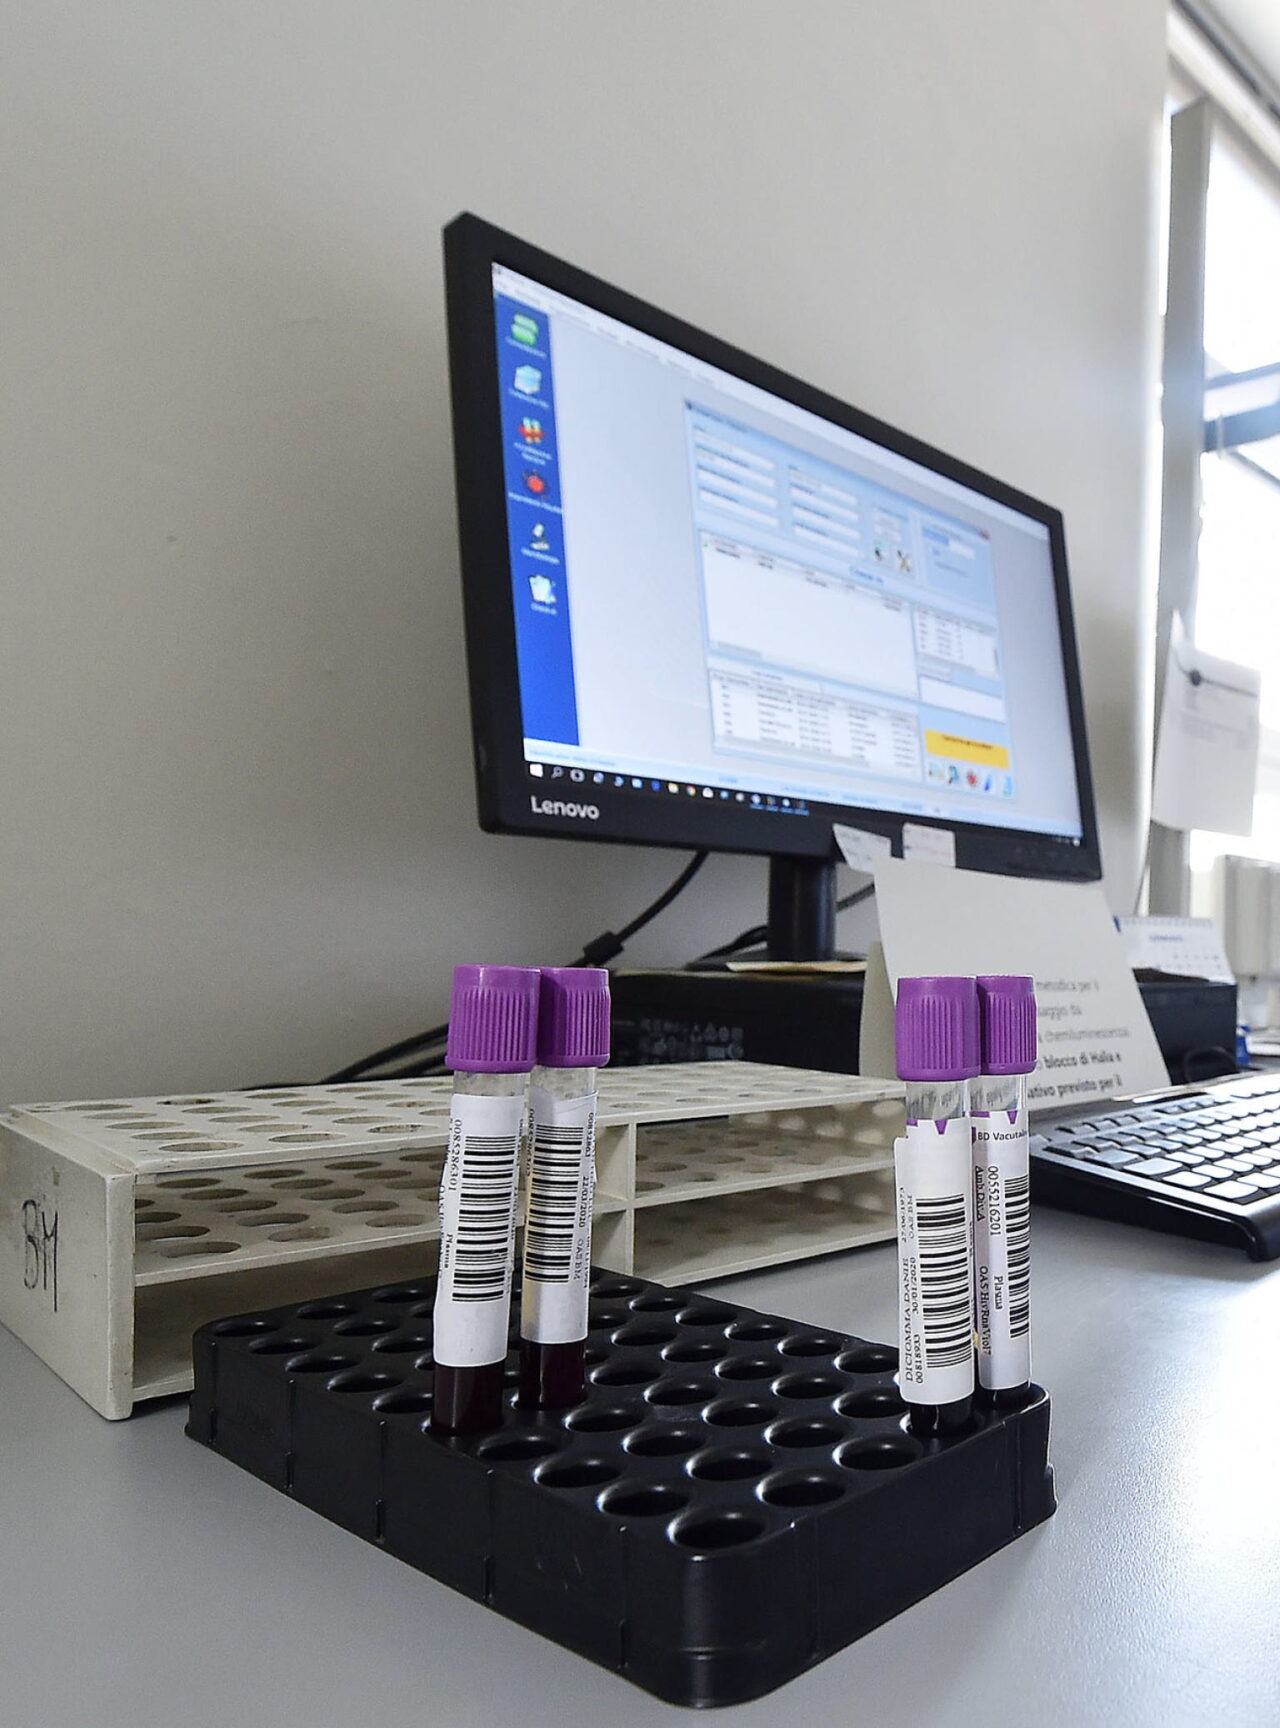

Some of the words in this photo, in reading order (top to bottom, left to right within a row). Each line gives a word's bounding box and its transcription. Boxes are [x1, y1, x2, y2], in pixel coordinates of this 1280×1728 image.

[530, 795, 600, 820] Lenovo
[978, 1131, 990, 1141] BD
[448, 1119, 462, 1192] 0085286301
[988, 1165, 1001, 1236] 0055216201
[444, 1233, 454, 1269] Plasma
[979, 1266, 989, 1290] OAS
[993, 1276, 1004, 1310] Plasma
